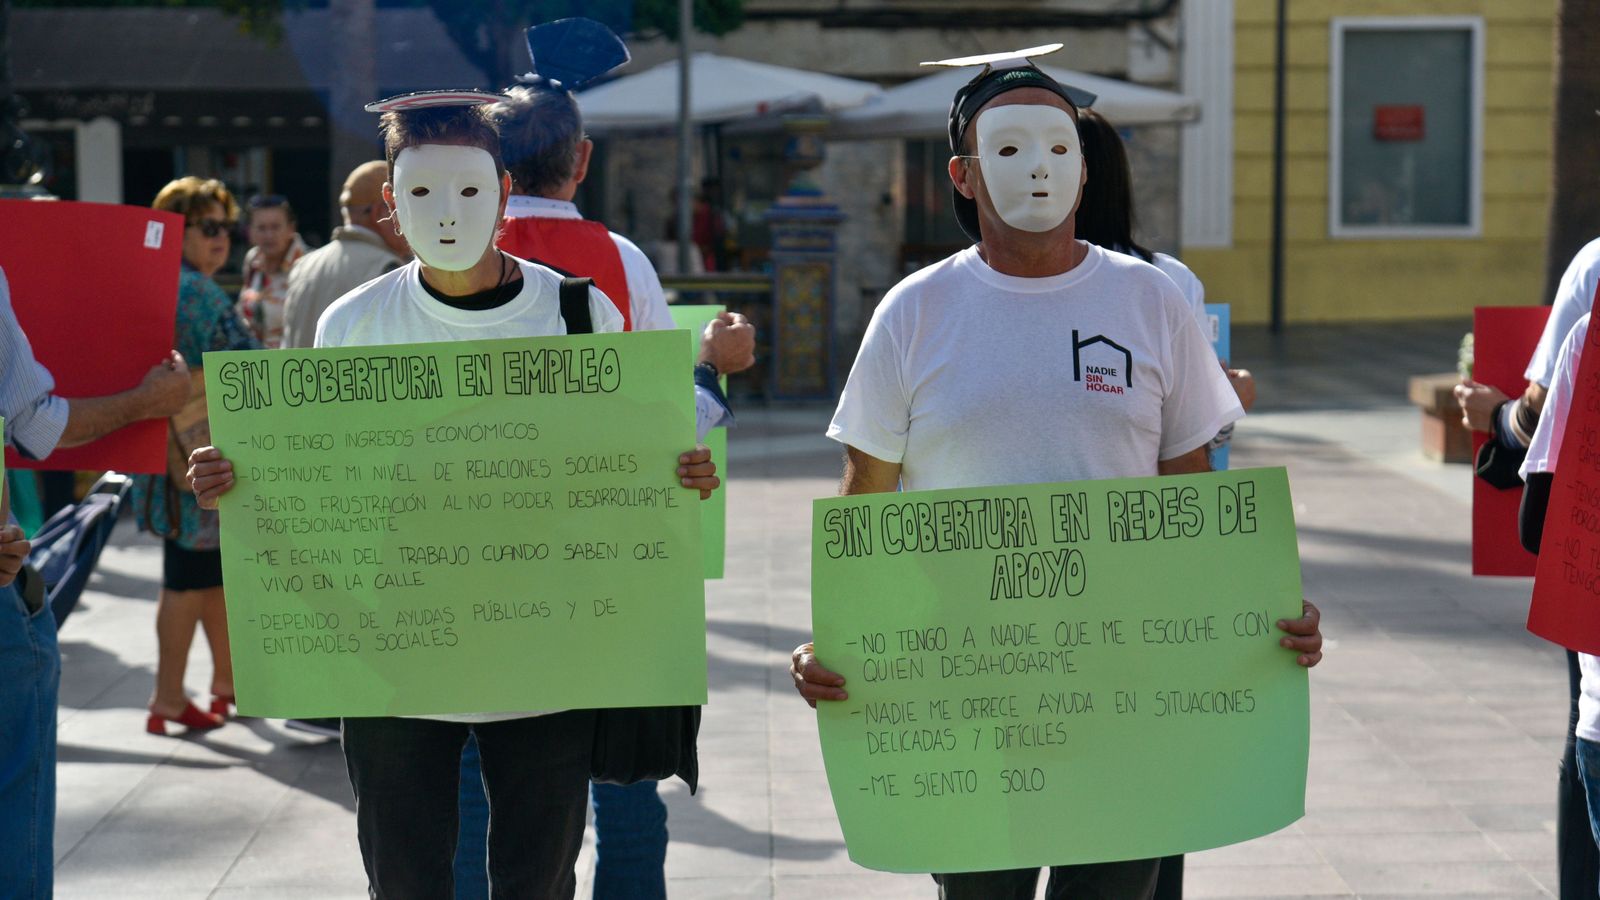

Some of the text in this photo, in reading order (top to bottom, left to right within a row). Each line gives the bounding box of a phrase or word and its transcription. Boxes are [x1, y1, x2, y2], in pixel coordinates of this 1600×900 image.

[281, 356, 443, 407] COBERTURA
[456, 354, 493, 397] EN
[503, 348, 621, 395] EMPLEO
[1086, 366, 1117, 376] NADIE
[1086, 374, 1103, 383] SIN
[1086, 382, 1124, 394] HOGAR
[284, 433, 334, 451] TENGO
[426, 422, 539, 443] ECONÓMICOS
[345, 466, 361, 481] MI
[373, 464, 416, 482] NIVEL
[434, 462, 454, 481] DE
[466, 459, 551, 480] RELACIONES
[320, 493, 426, 514] FRUSTRACIÓN
[443, 495, 462, 510] AL
[468, 493, 491, 510] NO
[503, 491, 553, 510] PODER
[568, 487, 678, 508] DESARROLLARME
[881, 498, 1037, 555] COBERTURA
[1051, 492, 1090, 543] EN
[1107, 487, 1204, 542] REDES
[1218, 481, 1256, 536] DE
[291, 549, 341, 565] ECHAN
[353, 548, 383, 565] DEL
[398, 546, 469, 565] TRABAJO
[482, 543, 549, 562] CUANDO
[564, 542, 617, 560] SABEN
[633, 542, 669, 560] QUE
[261, 571, 425, 592] VIVO EN LA CALLE
[990, 549, 1086, 600] APOYO
[360, 612, 380, 629] DE
[395, 607, 455, 627] AYUDAS
[473, 600, 551, 622] PÚBLICAS
[567, 602, 576, 620] Y
[594, 598, 617, 617] DE
[264, 634, 360, 654] ENTIDADES
[896, 627, 947, 652] TENGO
[962, 626, 975, 648] A
[991, 623, 1040, 647] NADIE
[1055, 621, 1091, 647] QUE
[1102, 620, 1125, 644] ME
[1143, 616, 1218, 644] ESCUCHE
[1233, 610, 1269, 637] CON
[863, 652, 1077, 683] QUIEN DESAHOGARME
[930, 700, 951, 720] ME
[962, 696, 1019, 719] OFRECE
[1038, 692, 1094, 714] AYUDA
[1115, 691, 1136, 714] EN
[1155, 689, 1255, 717] SITUACIONES
[867, 728, 956, 755] DELICADAS
[973, 728, 981, 751] Y
[1000, 768, 1045, 793] SOLO
